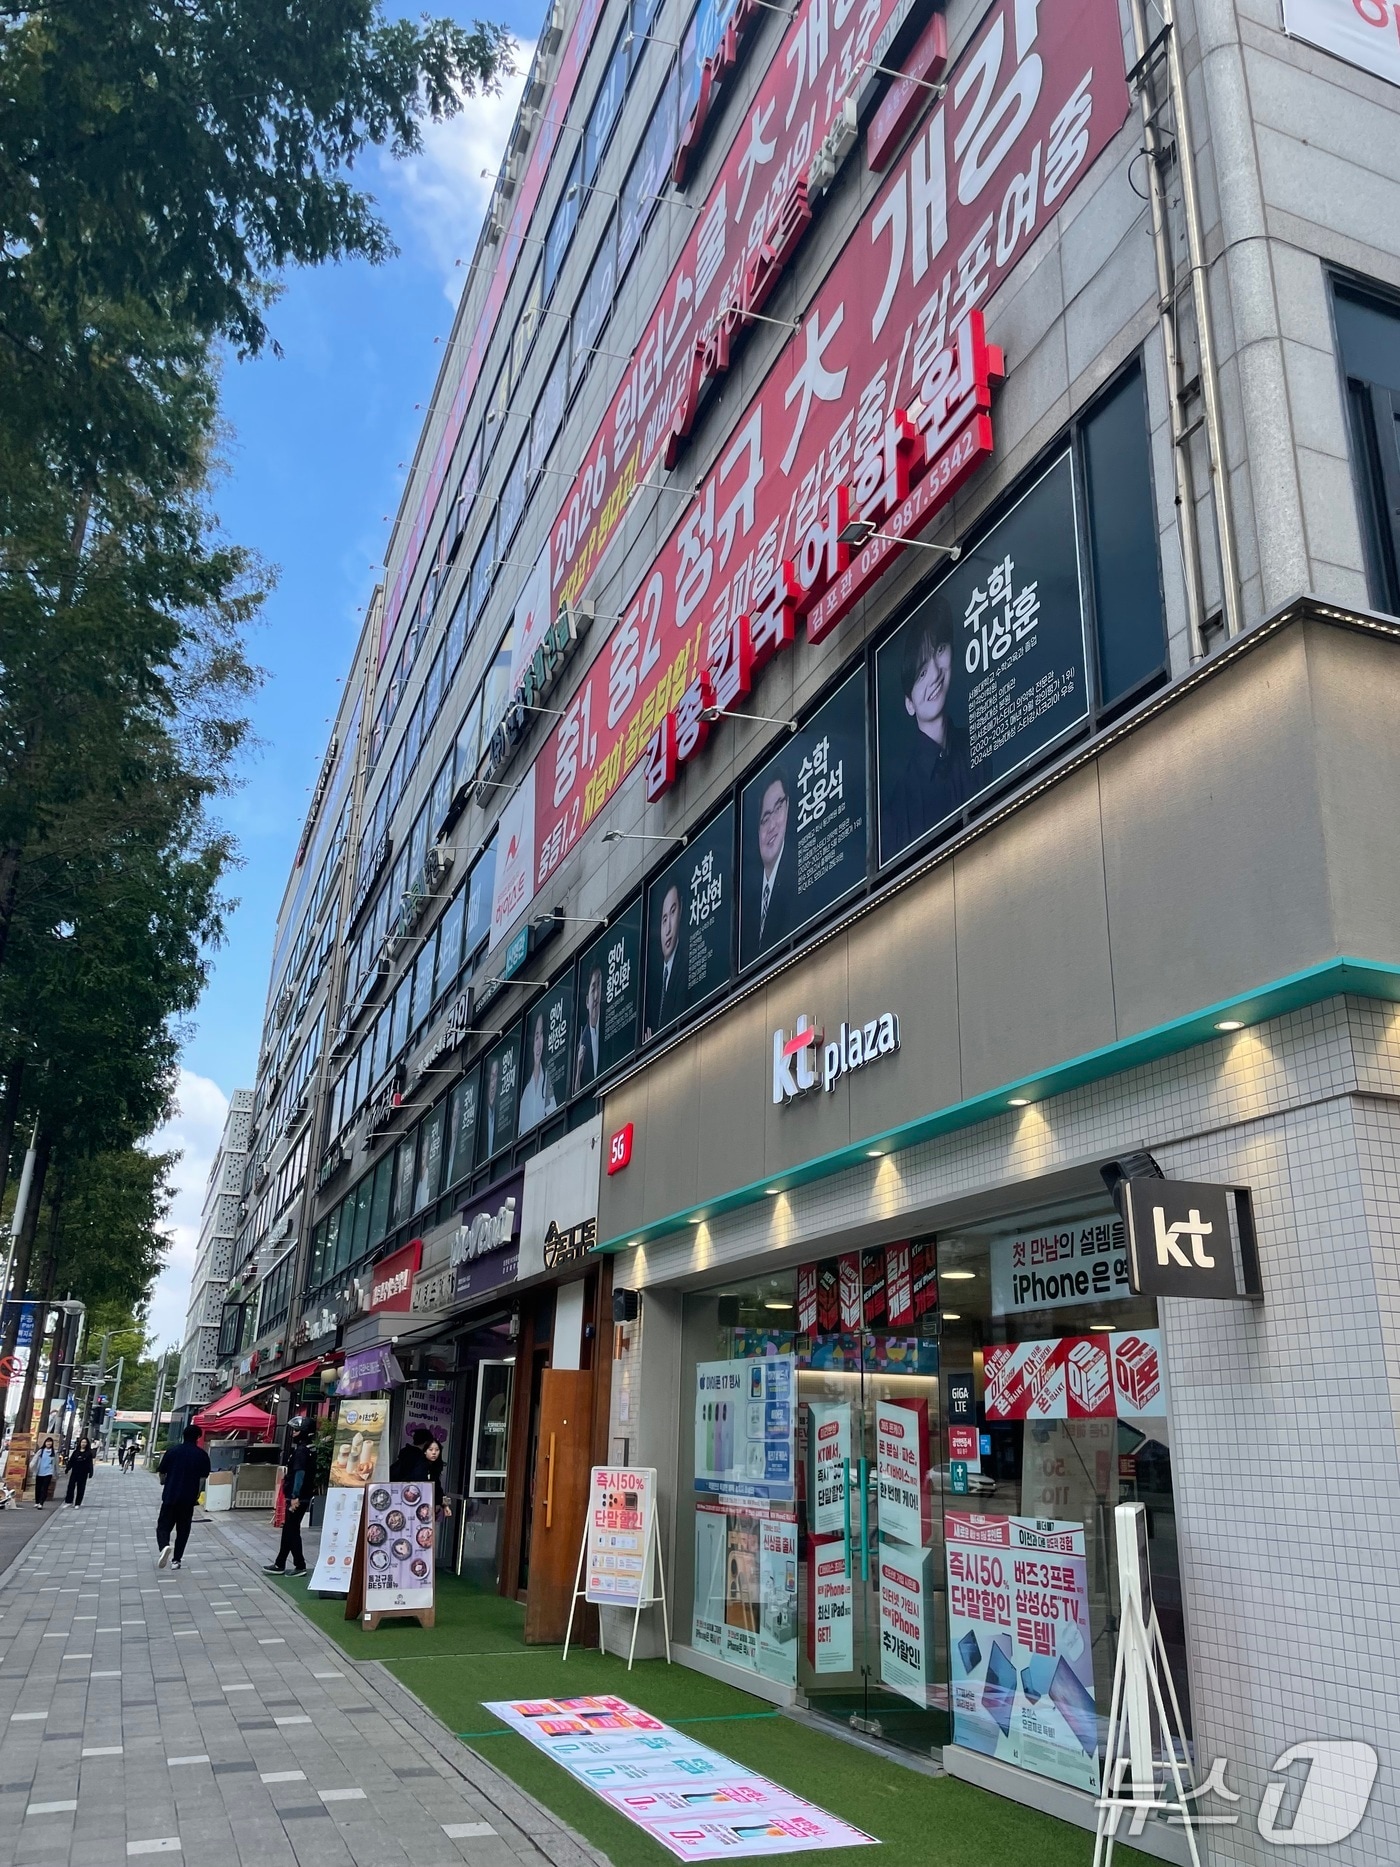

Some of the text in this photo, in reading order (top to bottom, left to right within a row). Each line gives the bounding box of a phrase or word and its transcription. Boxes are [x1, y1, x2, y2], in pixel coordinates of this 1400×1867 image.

[747, 99, 818, 262] 역전의
[553, 679, 598, 808] 중1,
[607, 570, 664, 730] 중2
[675, 403, 764, 629] 정규
[872, 0, 1043, 343] 개강
[552, 434, 607, 592] 2026
[646, 310, 984, 801] 김종길국어학원
[963, 553, 1014, 633] 수학
[965, 580, 1040, 673] 이상훈
[967, 670, 994, 702] 서울대학교
[537, 796, 580, 884] 중등1,2
[581, 732, 625, 829] 지금이
[623, 622, 702, 775] 골든타임!
[797, 735, 829, 793] 수학
[970, 743, 992, 769] 2024년
[796, 760, 843, 833] 조용석
[690, 850, 714, 896] 수학
[689, 873, 722, 926] 차상현
[607, 936, 625, 975] 영어
[550, 998, 563, 1030] 영어
[773, 1012, 901, 1104] kt plaza
[611, 1133, 625, 1163] 5G
[1012, 1220, 1126, 1268] 첫 만남의 설렘을
[1153, 1206, 1215, 1268] kt
[888, 1248, 909, 1285] 즉시
[888, 1283, 911, 1322] 개통
[706, 1374, 740, 1390] 아이폰 17 행사
[952, 1387, 969, 1399] GiGA
[954, 1401, 967, 1413] LTE
[818, 1442, 841, 1463] KT에서,
[879, 1440, 885, 1454] 폰
[596, 1472, 644, 1491] 즉시50%
[880, 1482, 887, 1499] 한
[888, 1486, 901, 1504] 번에
[595, 1509, 643, 1530] 단말할인
[763, 1534, 795, 1556] 신상품 출시
[1019, 1530, 1037, 1546] 이전과
[1059, 1536, 1073, 1551] 경험
[950, 1552, 1010, 1590] 즉시50%
[818, 1603, 831, 1620] 최신
[882, 1586, 899, 1605] 인터넷
[951, 1585, 1011, 1626] 단말할인
[817, 1625, 831, 1643] GET!
[891, 1608, 920, 1641] iPhone
[1017, 1617, 1056, 1657] 득템!
[1089, 1776, 1096, 1787] kt
